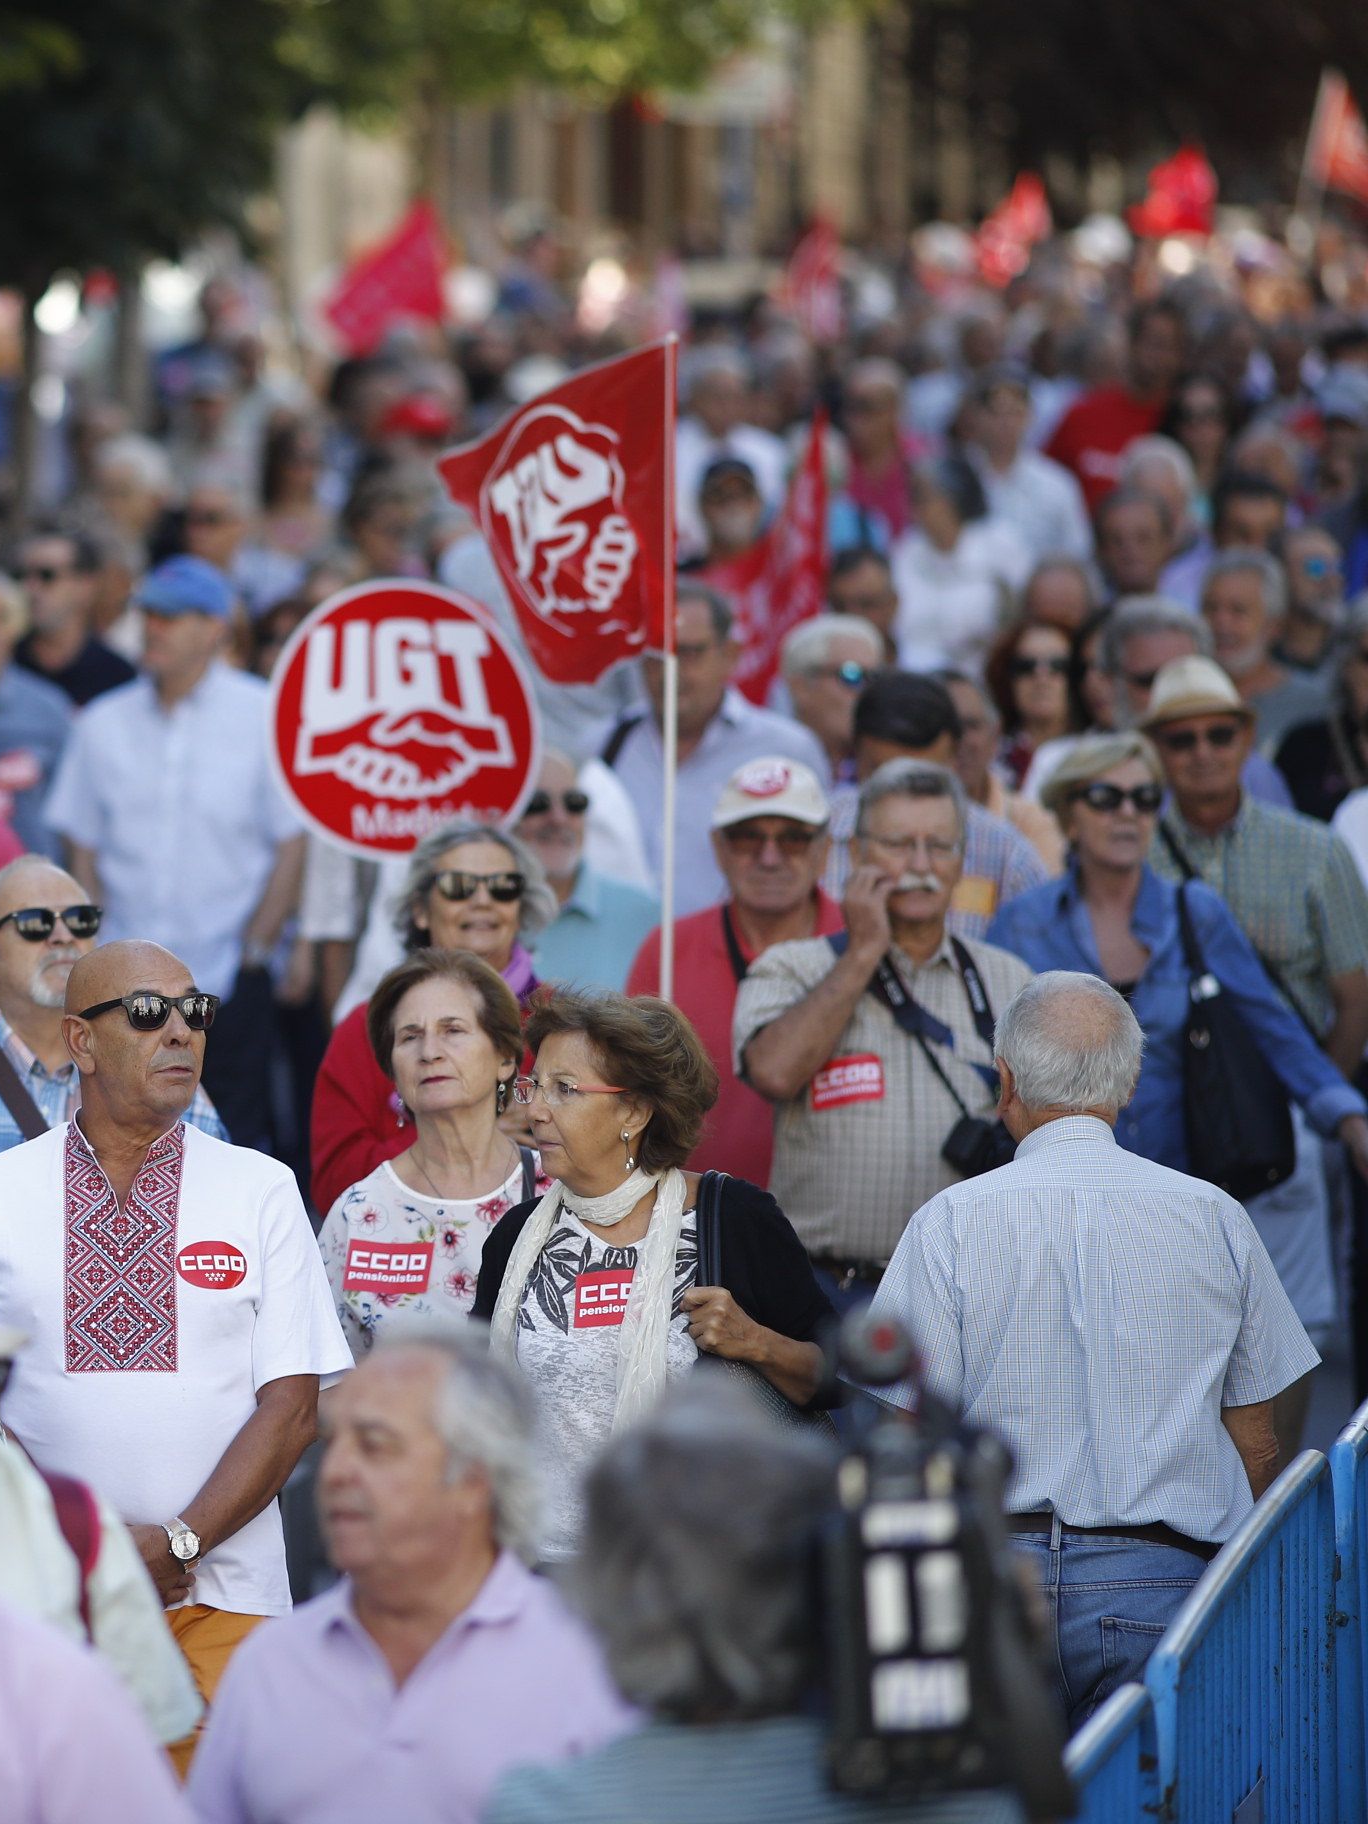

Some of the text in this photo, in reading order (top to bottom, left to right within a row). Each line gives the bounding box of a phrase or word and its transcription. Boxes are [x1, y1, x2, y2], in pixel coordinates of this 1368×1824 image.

[301, 617, 492, 731] UGT
[814, 1062, 880, 1092] CCOO
[179, 1254, 246, 1273] CCOO
[350, 1250, 428, 1271] CCOO
[347, 1270, 425, 1284] pensionistas
[580, 1282, 633, 1304] CCO
[579, 1303, 628, 1318] pension
